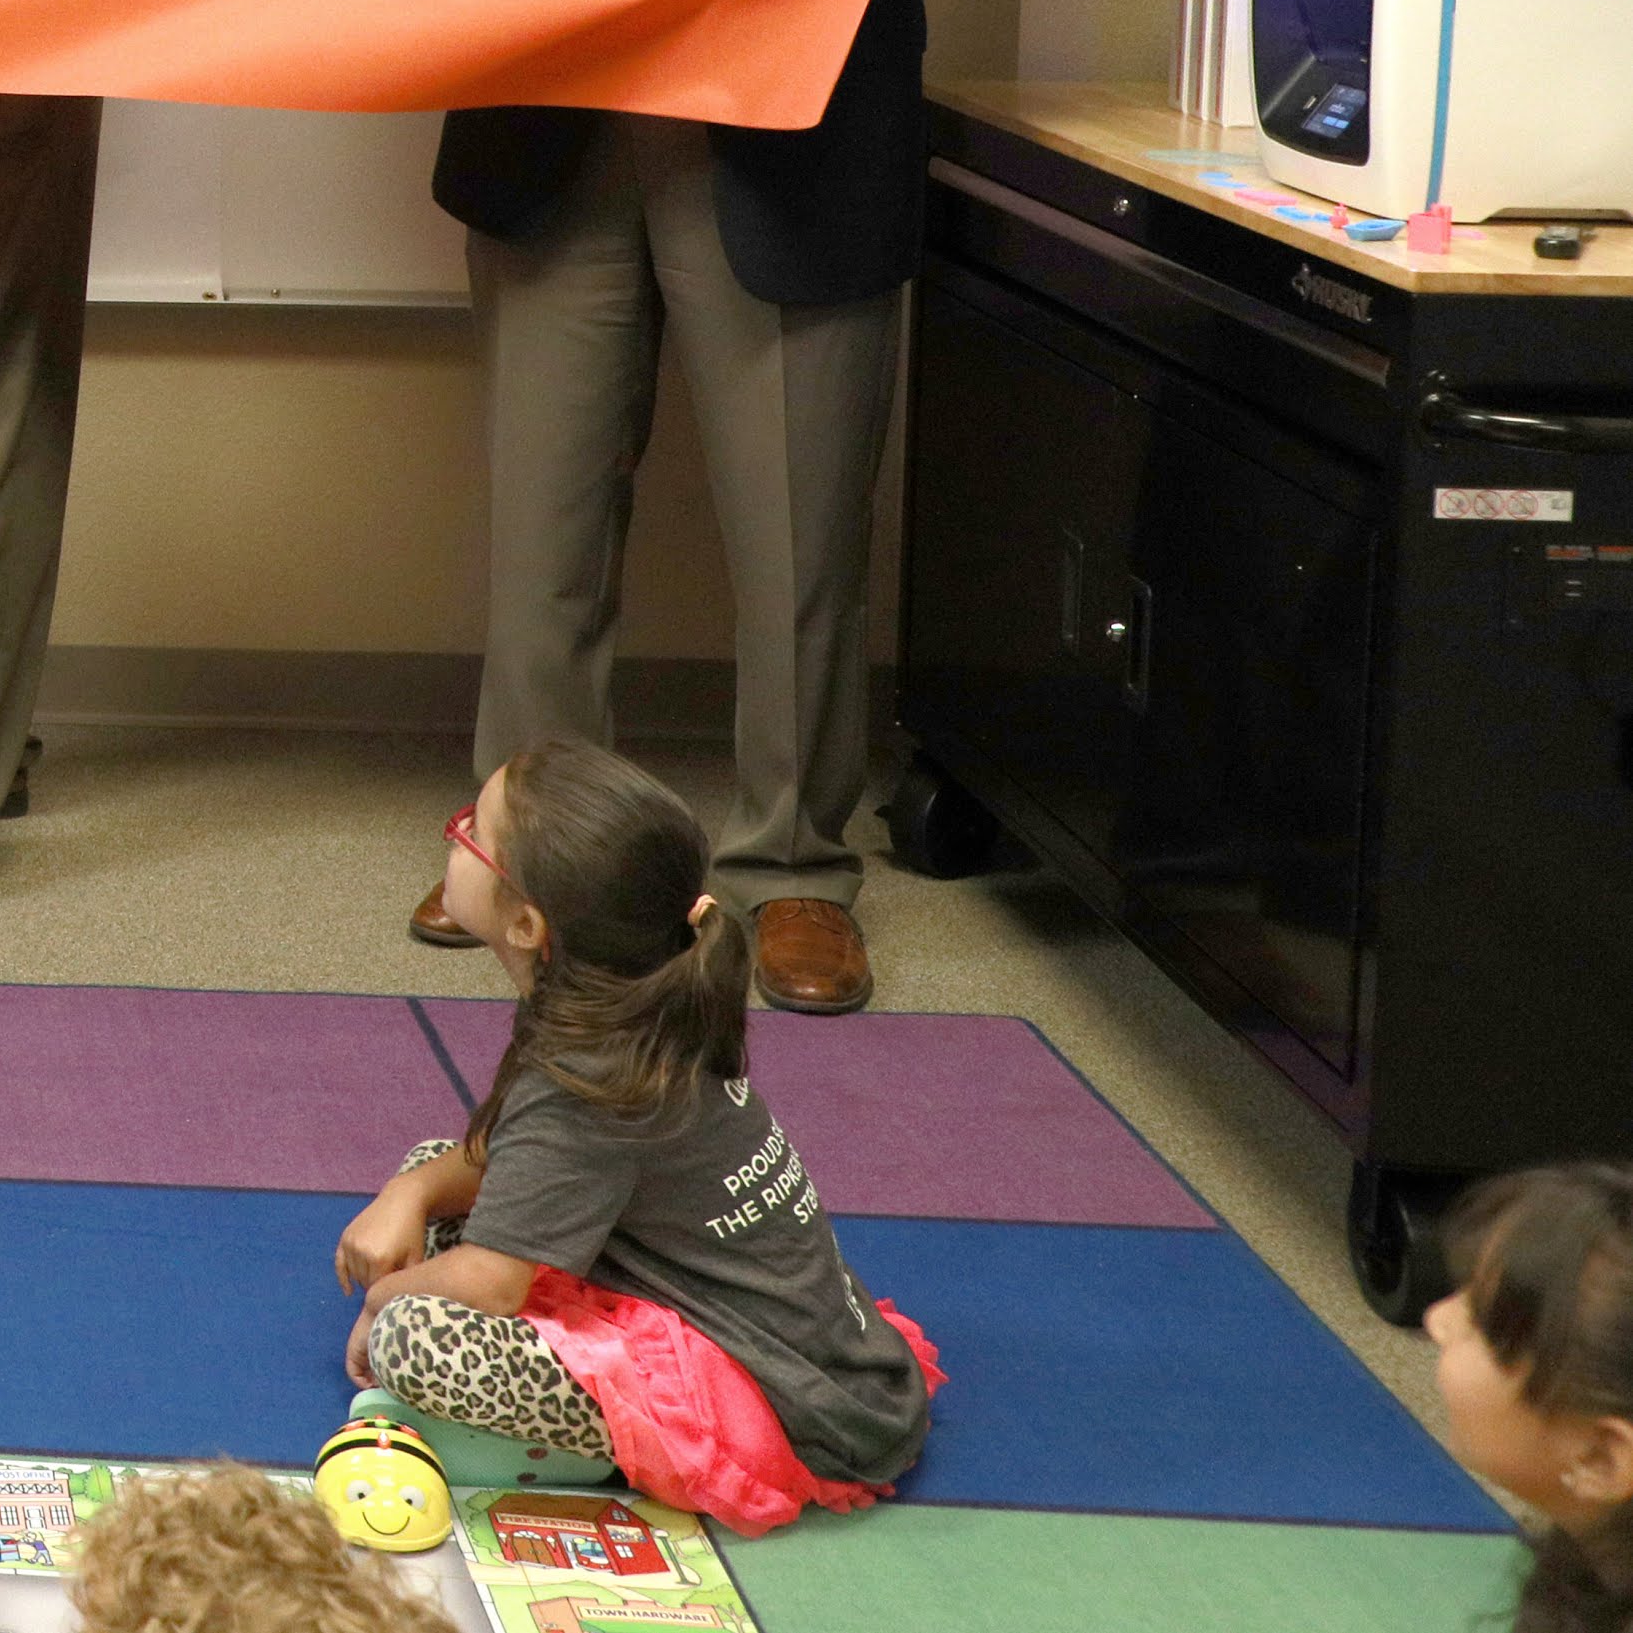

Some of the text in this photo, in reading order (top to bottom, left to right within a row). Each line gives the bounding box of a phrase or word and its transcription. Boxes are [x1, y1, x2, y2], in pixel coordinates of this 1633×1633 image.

[723, 1136, 783, 1196] PROUD
[706, 1200, 762, 1239] THE
[585, 1608, 709, 1623] TOWN HARDWARE
